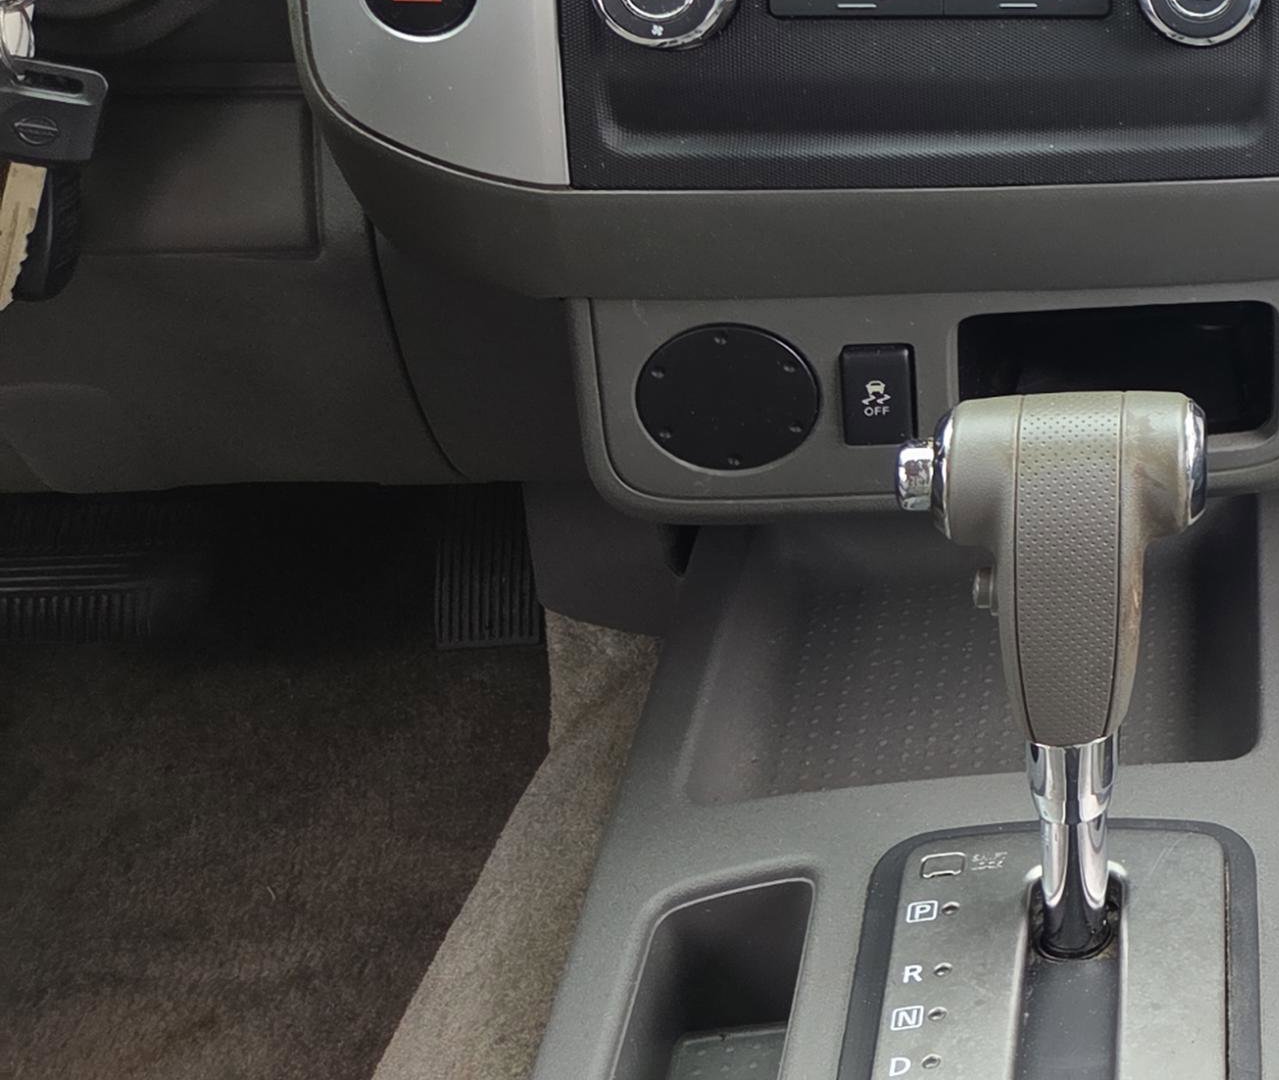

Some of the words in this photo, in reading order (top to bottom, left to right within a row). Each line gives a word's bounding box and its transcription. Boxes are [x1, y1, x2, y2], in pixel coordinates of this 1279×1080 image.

[864, 406, 890, 417] OFF
[902, 964, 923, 983] R
[889, 1057, 911, 1077] D
